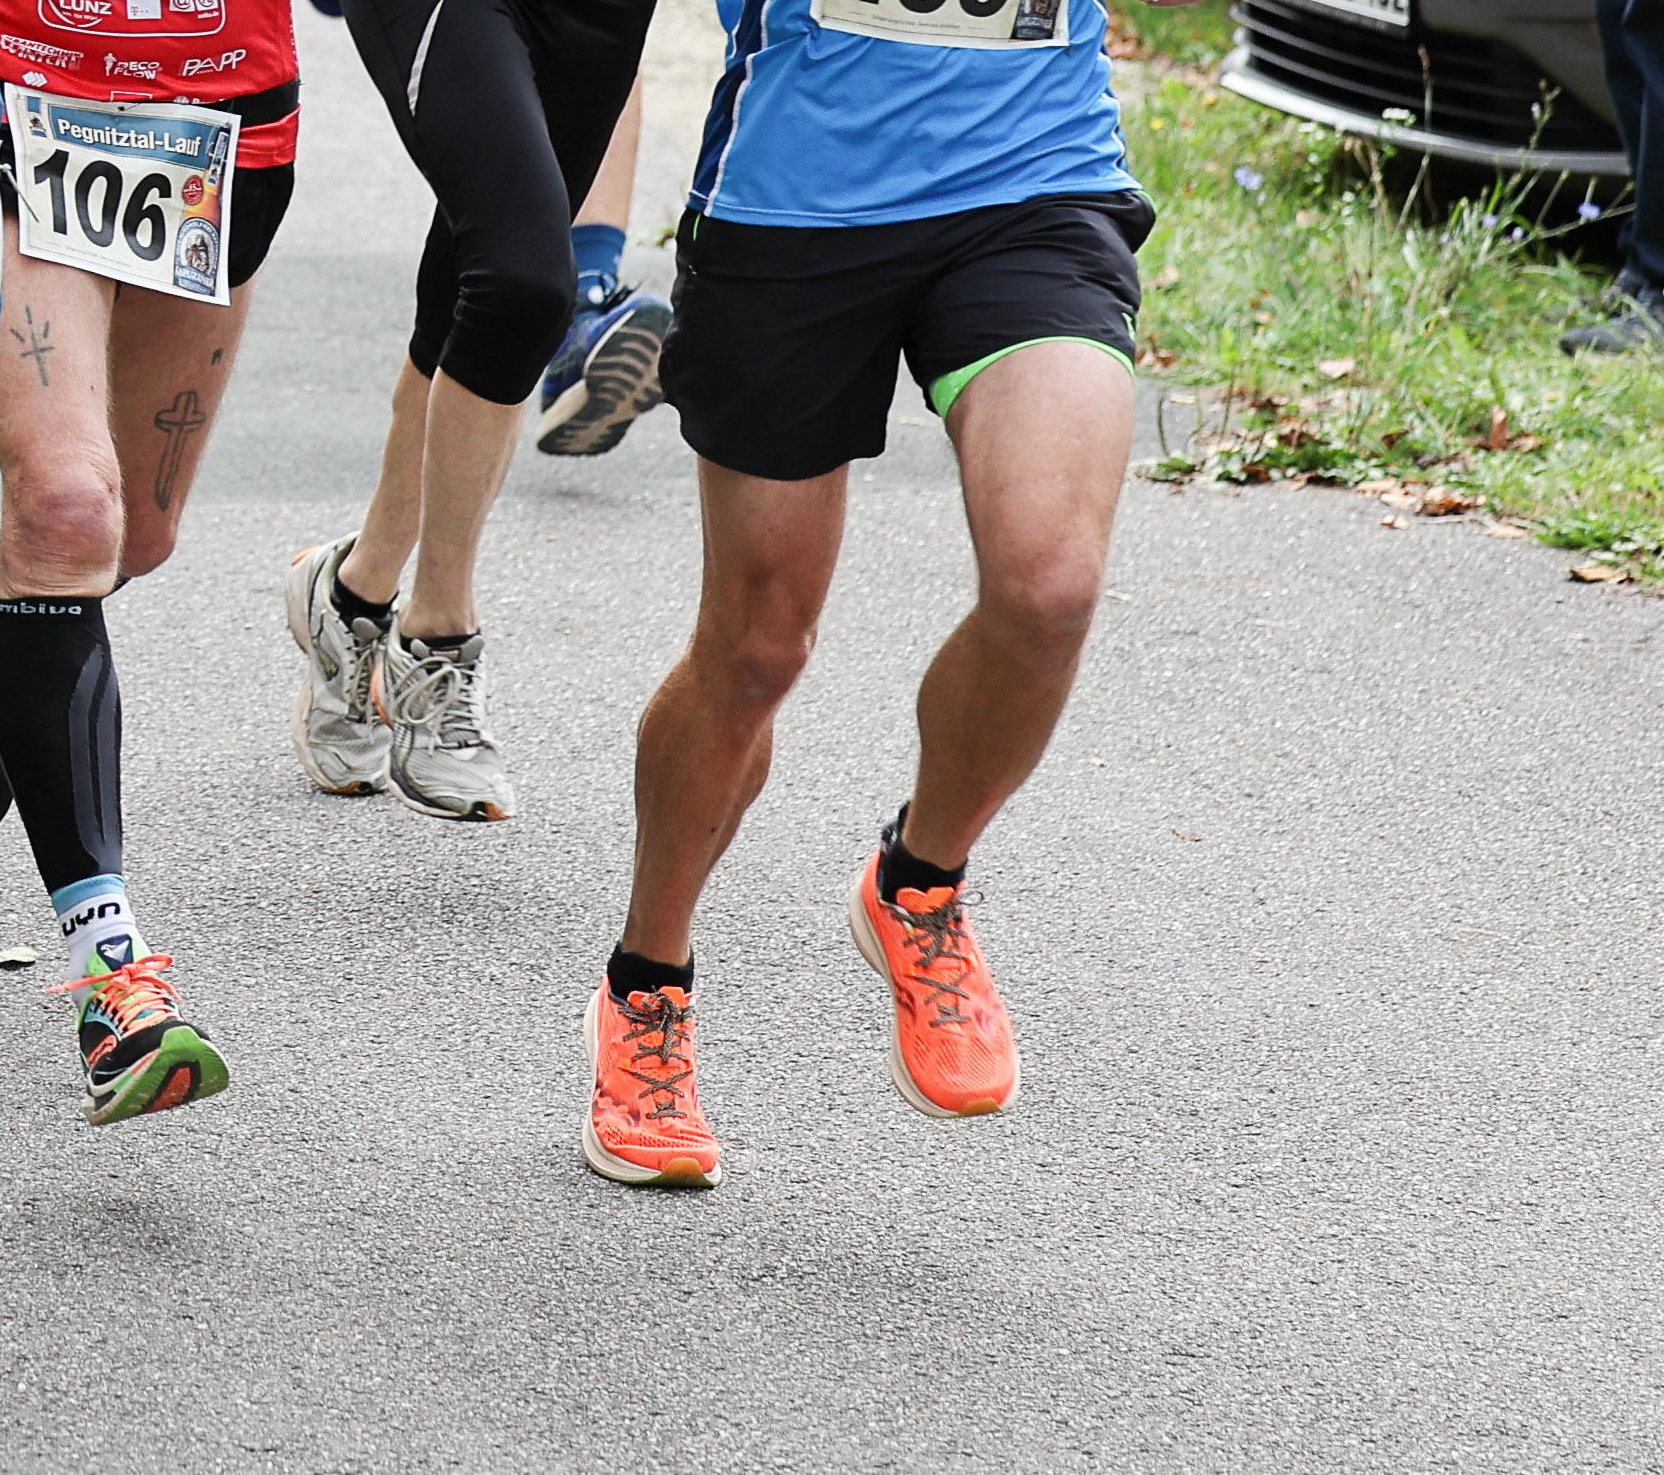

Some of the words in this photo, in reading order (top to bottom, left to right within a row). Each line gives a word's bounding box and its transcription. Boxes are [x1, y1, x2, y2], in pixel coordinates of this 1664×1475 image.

[183, 48, 247, 77] PAPP
[58, 118, 202, 158] Pegnitztal-Lauf
[33, 148, 172, 262] 106
